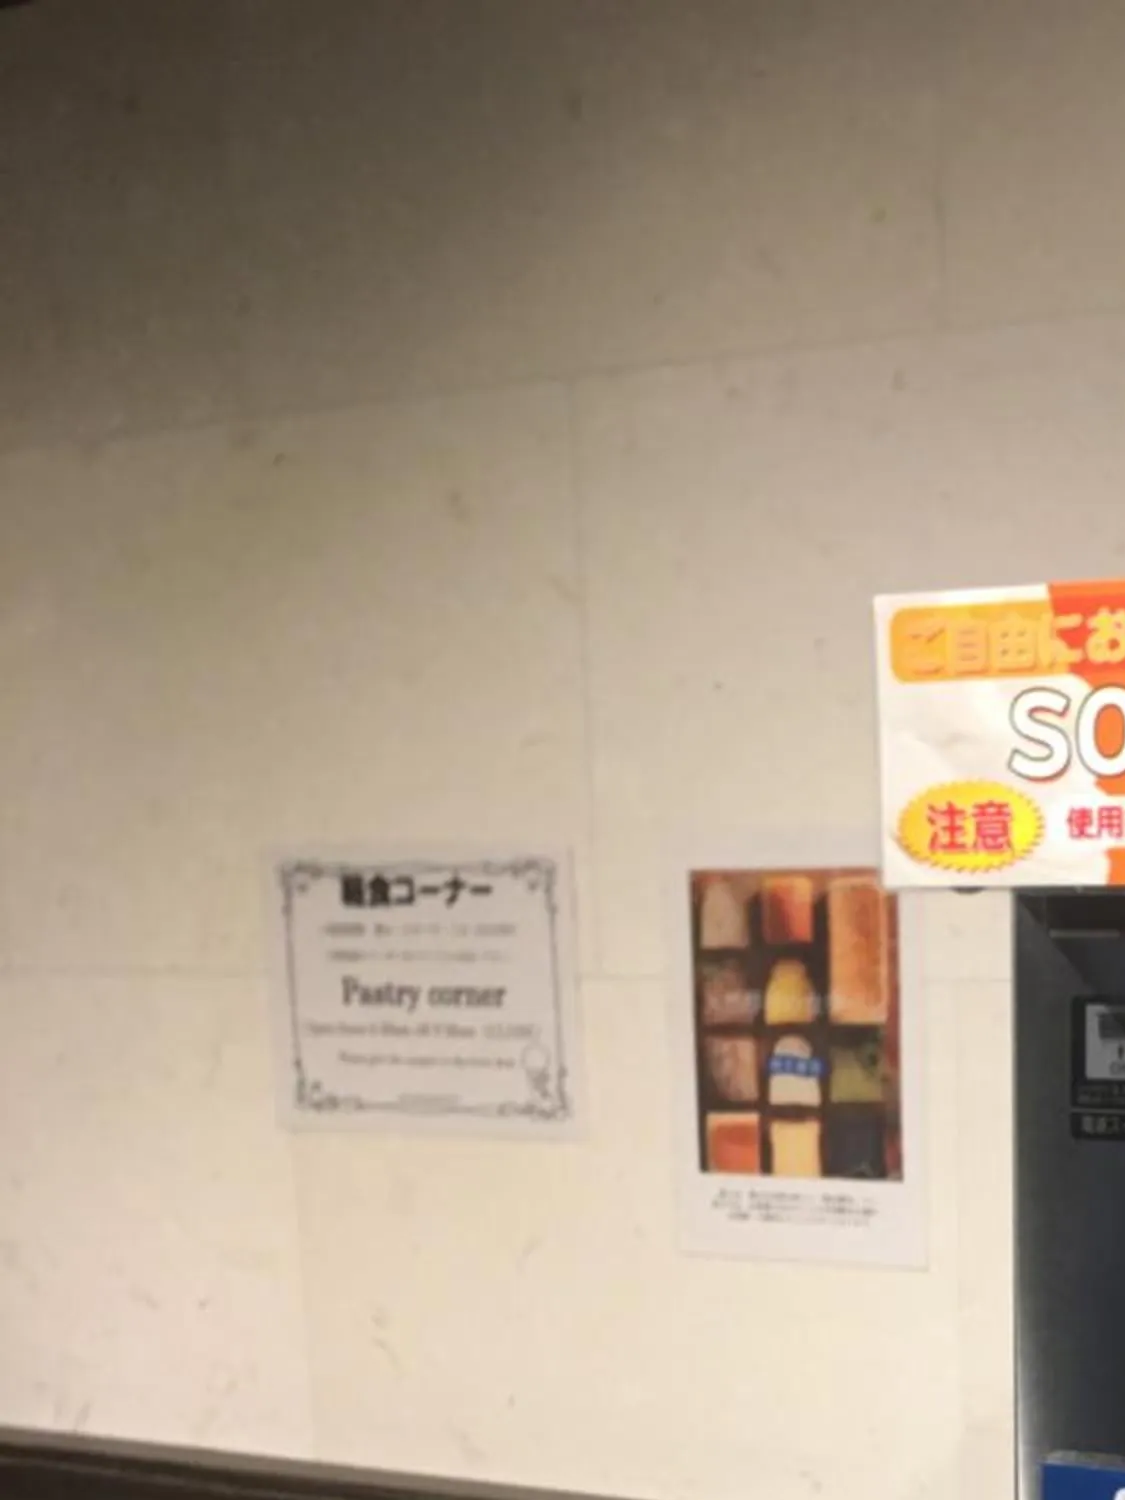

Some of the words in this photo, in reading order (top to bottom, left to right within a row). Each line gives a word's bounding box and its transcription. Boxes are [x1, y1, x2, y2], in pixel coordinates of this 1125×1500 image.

[925, 800, 1014, 856] 注意
[341, 974, 420, 1015] Pastry
[427, 985, 507, 1008] corner
